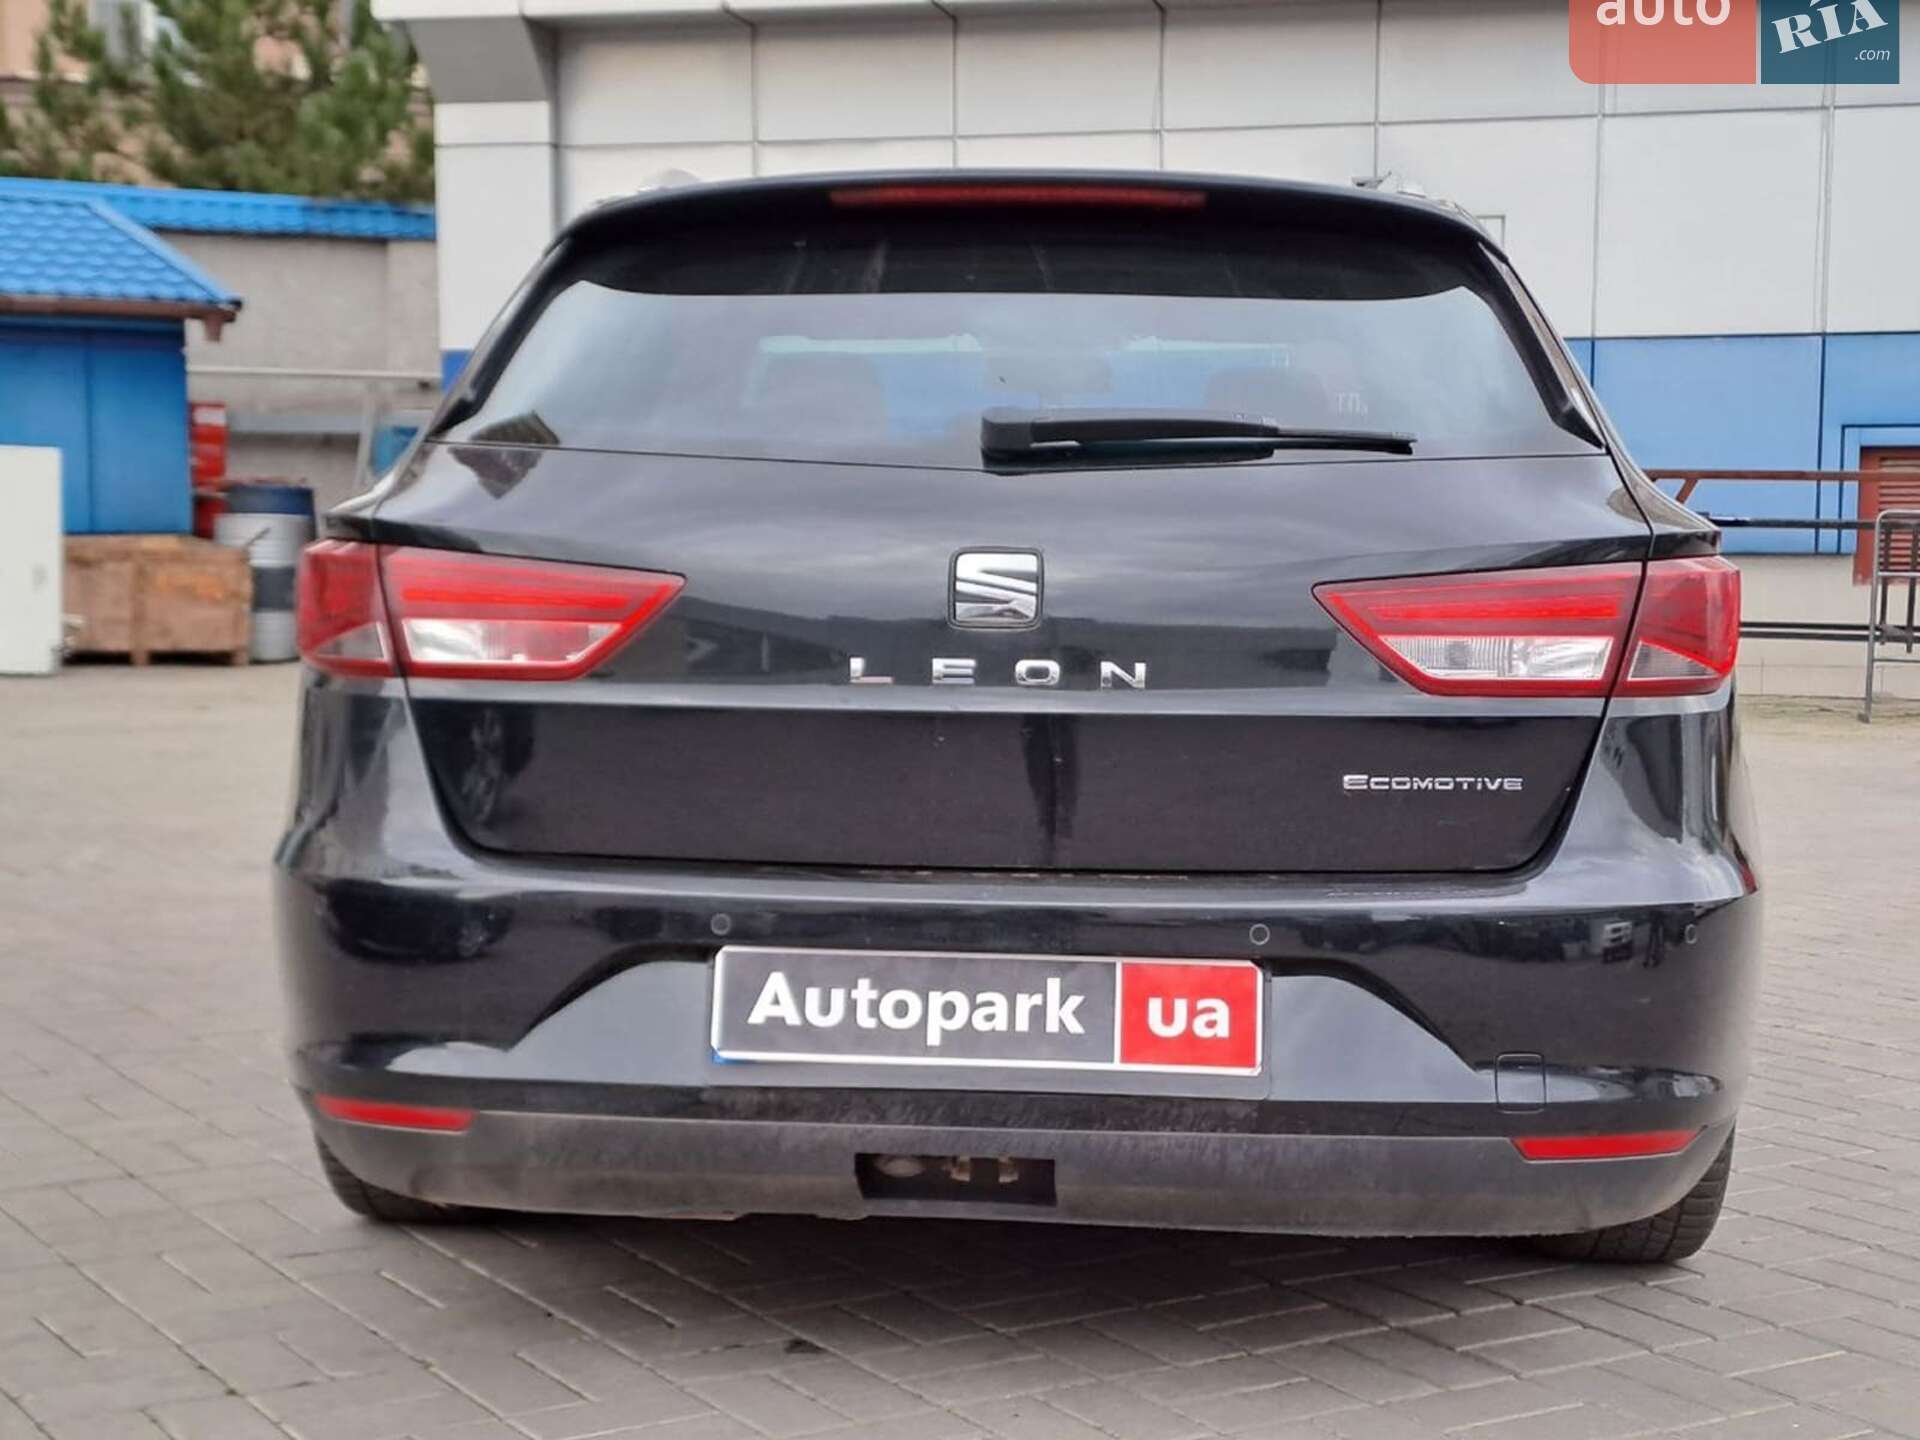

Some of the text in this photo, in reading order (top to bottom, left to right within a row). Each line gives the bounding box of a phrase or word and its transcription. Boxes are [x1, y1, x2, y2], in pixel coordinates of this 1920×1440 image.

[849, 656, 1147, 689] LEON
[747, 970, 1231, 1047] Autopark ua
